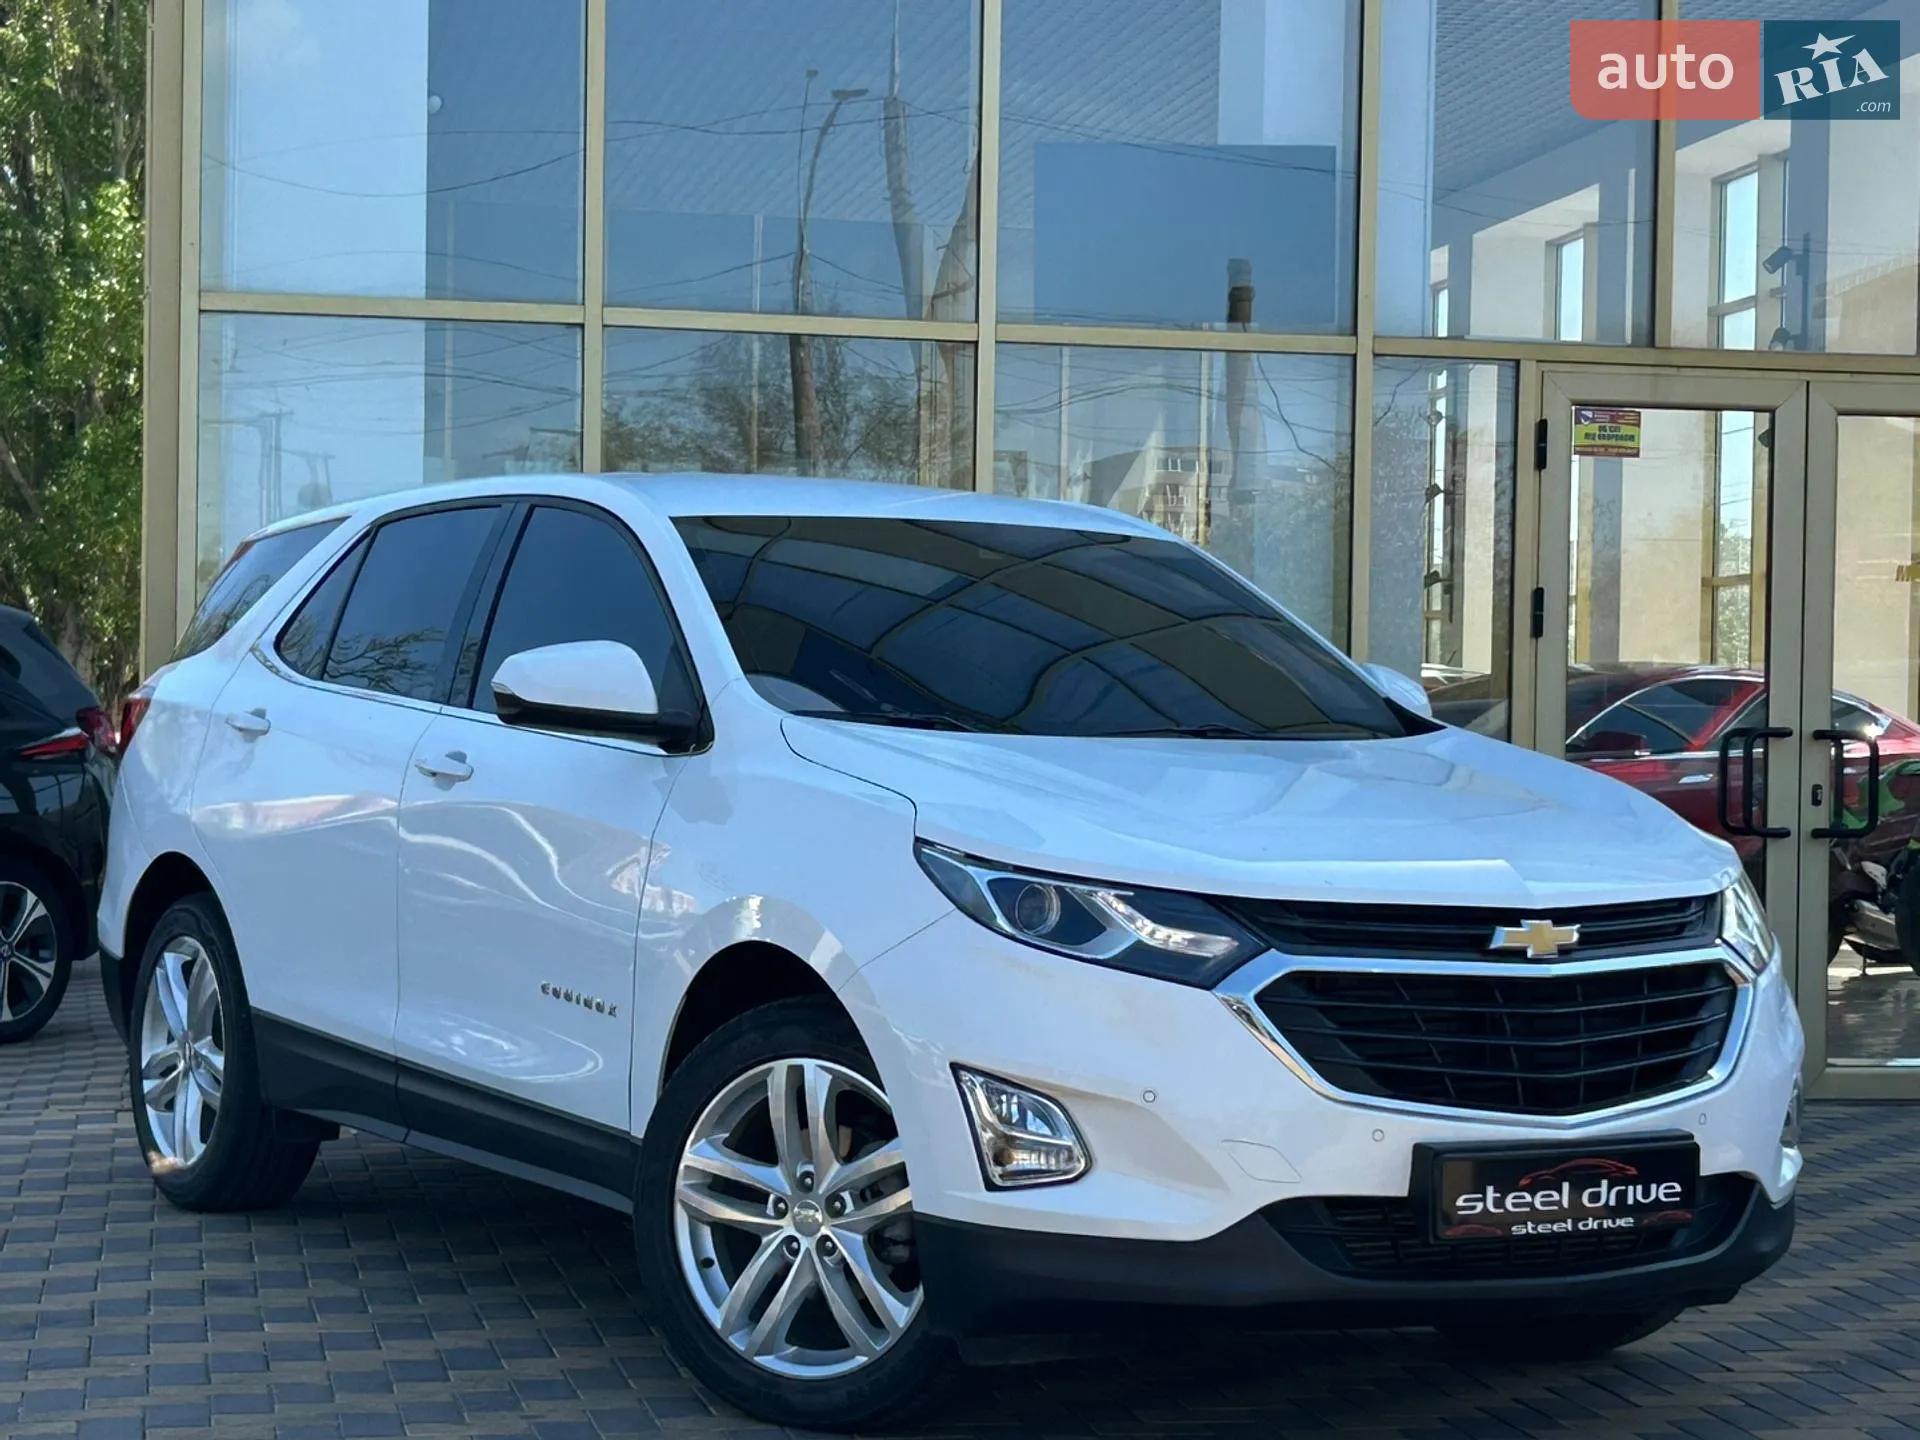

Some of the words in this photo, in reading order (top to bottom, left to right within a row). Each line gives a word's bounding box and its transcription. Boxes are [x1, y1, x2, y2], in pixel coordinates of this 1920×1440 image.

[1455, 1181, 1570, 1215] steel
[1581, 1178, 1683, 1208] drive
[1511, 1219, 1573, 1235] steel
[1578, 1216, 1634, 1232] drive
